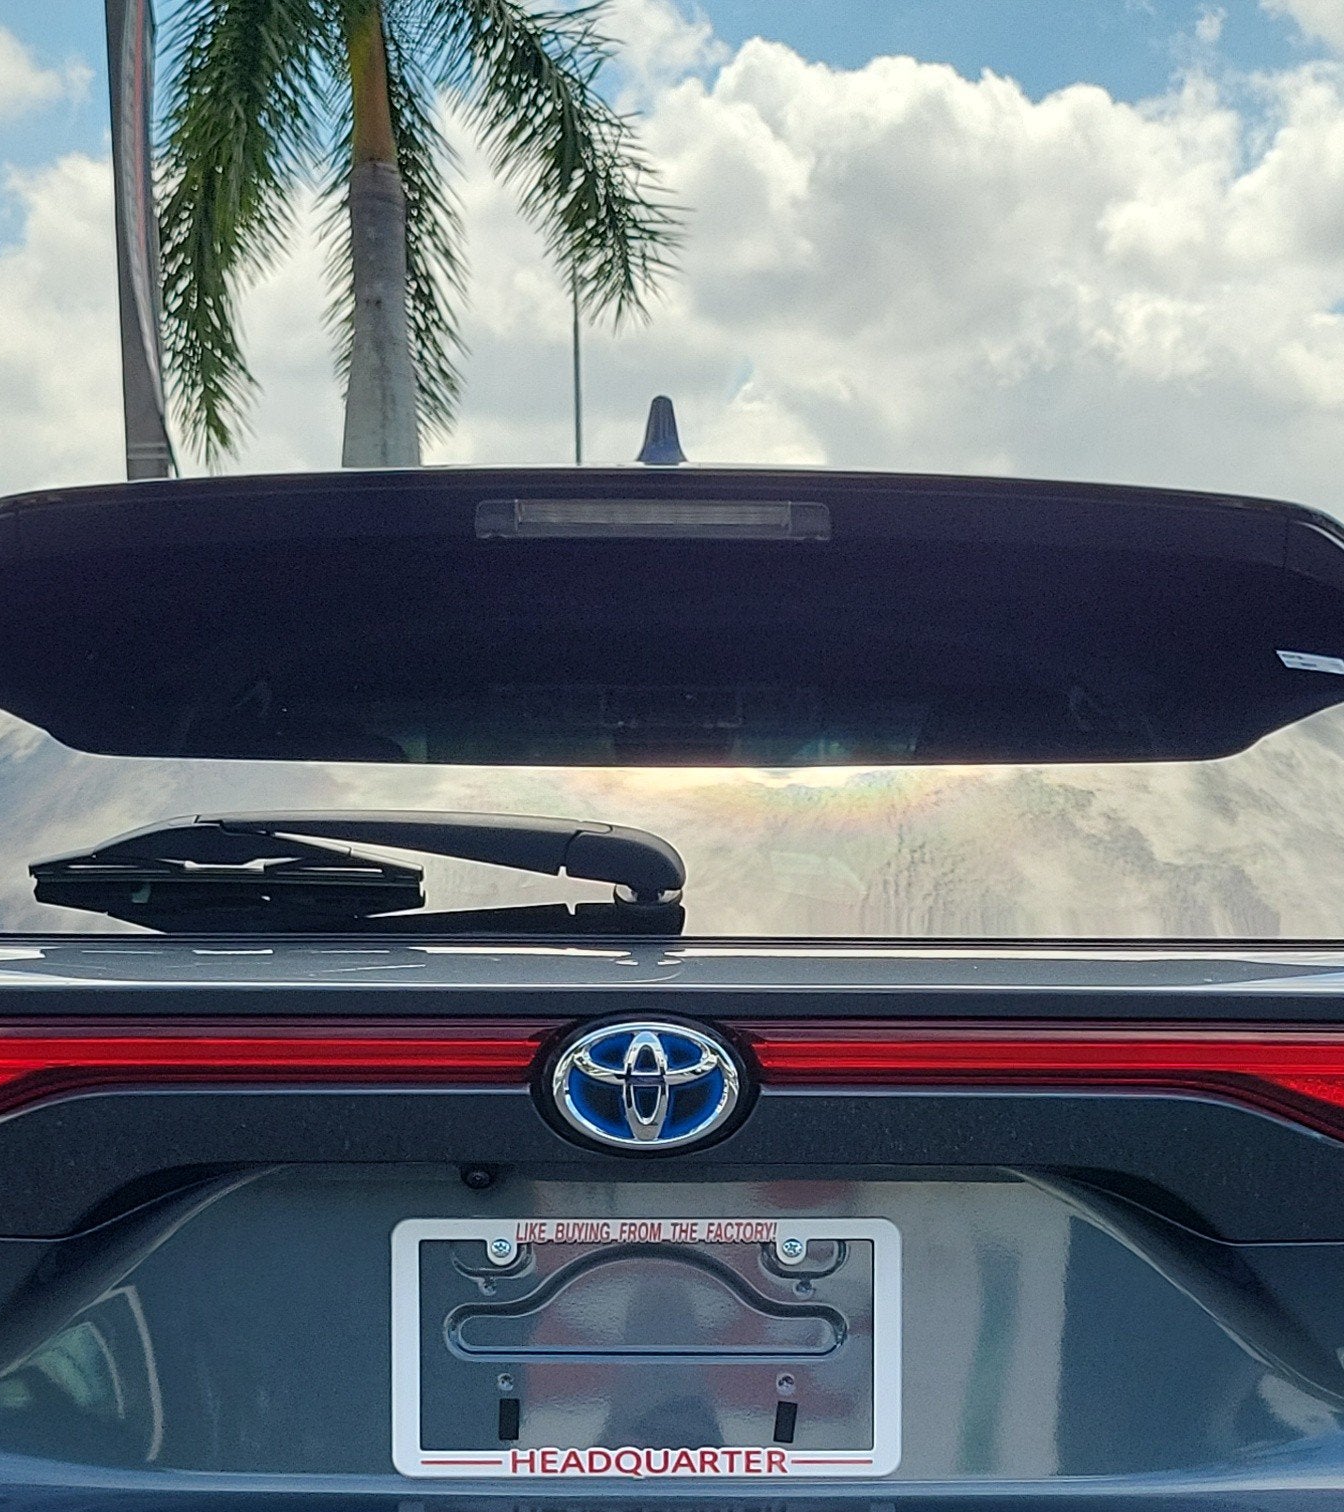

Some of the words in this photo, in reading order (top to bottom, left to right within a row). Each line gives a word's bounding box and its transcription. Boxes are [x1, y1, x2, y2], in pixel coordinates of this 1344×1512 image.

[515, 1222, 547, 1241] LIKE
[556, 1222, 611, 1241] BUYING
[619, 1222, 662, 1241] FROM
[670, 1222, 699, 1241] THE
[706, 1222, 778, 1241] FACTORY!
[510, 1450, 788, 1477] HEADQUARTER
